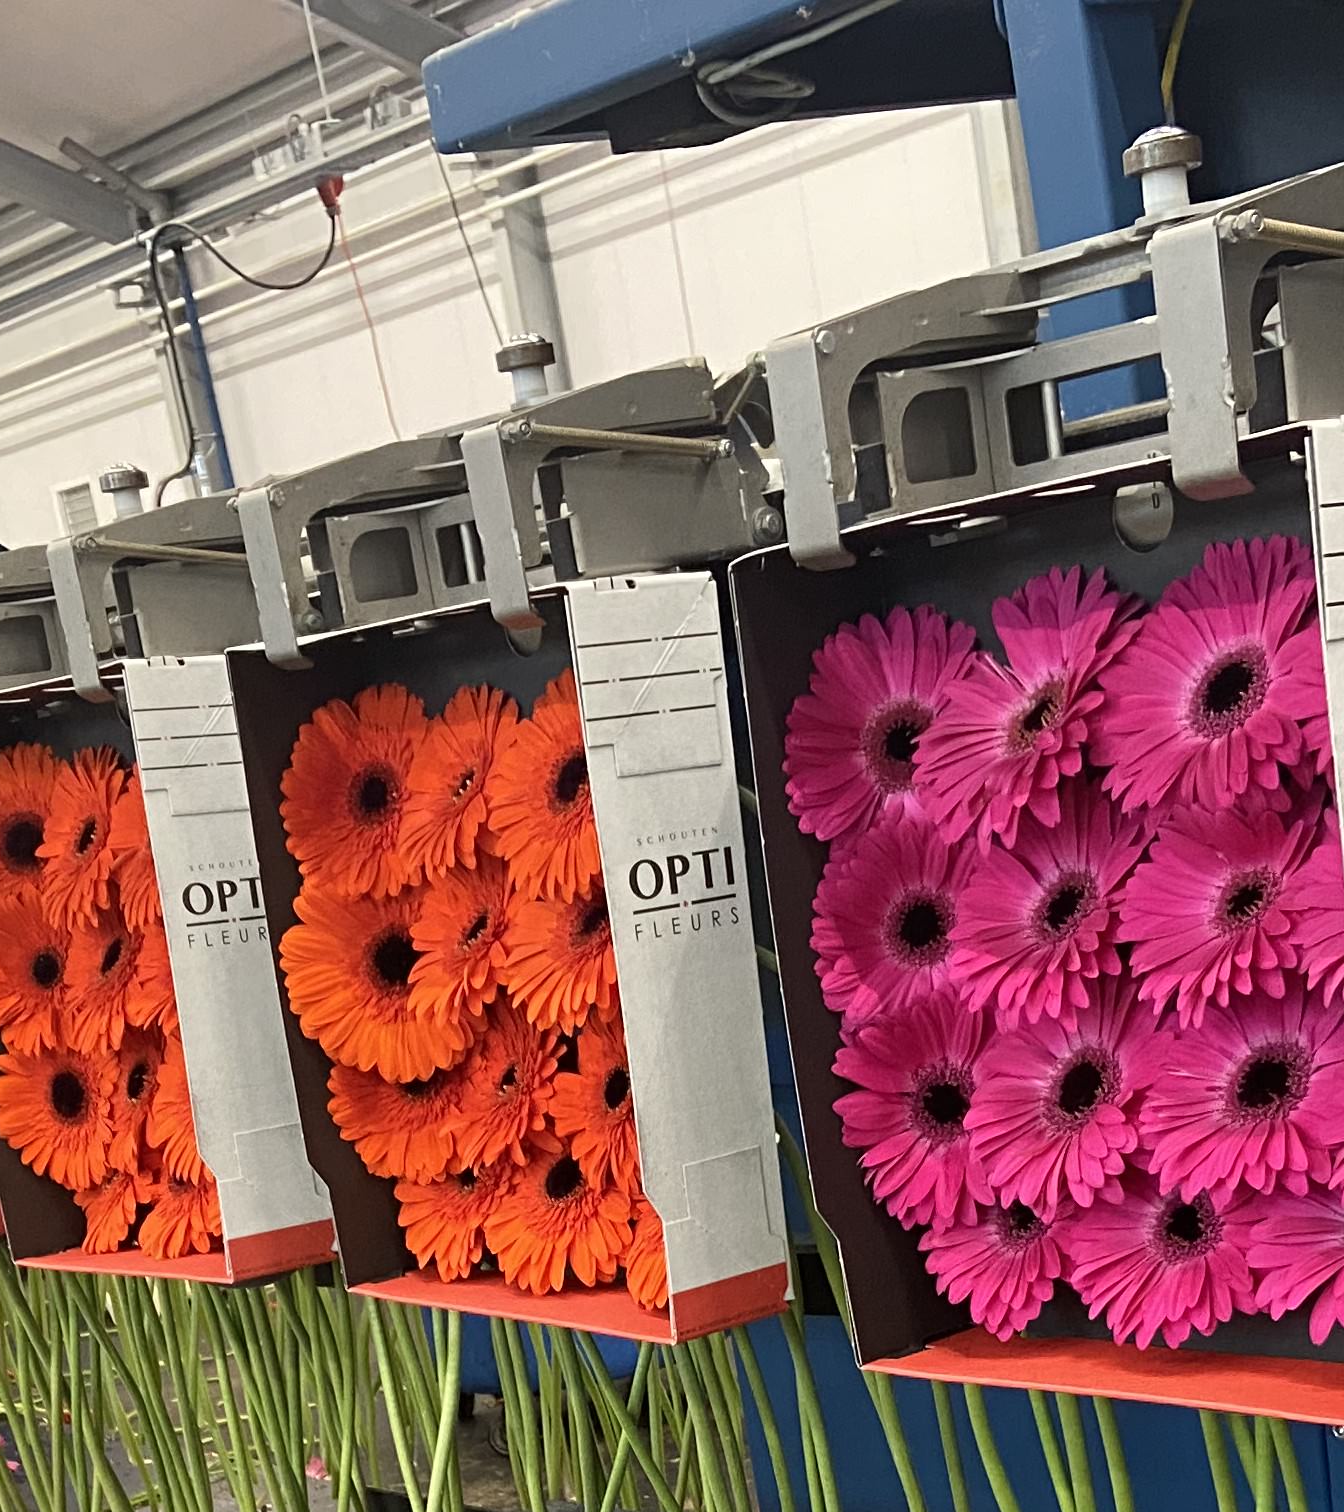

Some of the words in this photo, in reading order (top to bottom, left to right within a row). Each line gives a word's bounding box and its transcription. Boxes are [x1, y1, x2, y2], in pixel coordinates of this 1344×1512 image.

[637, 826, 719, 847] SCHOUTEN
[628, 846, 735, 900] OPTI
[182, 877, 260, 915] OPT
[187, 926, 267, 949] FLEUR
[634, 907, 739, 942] FLEURS
